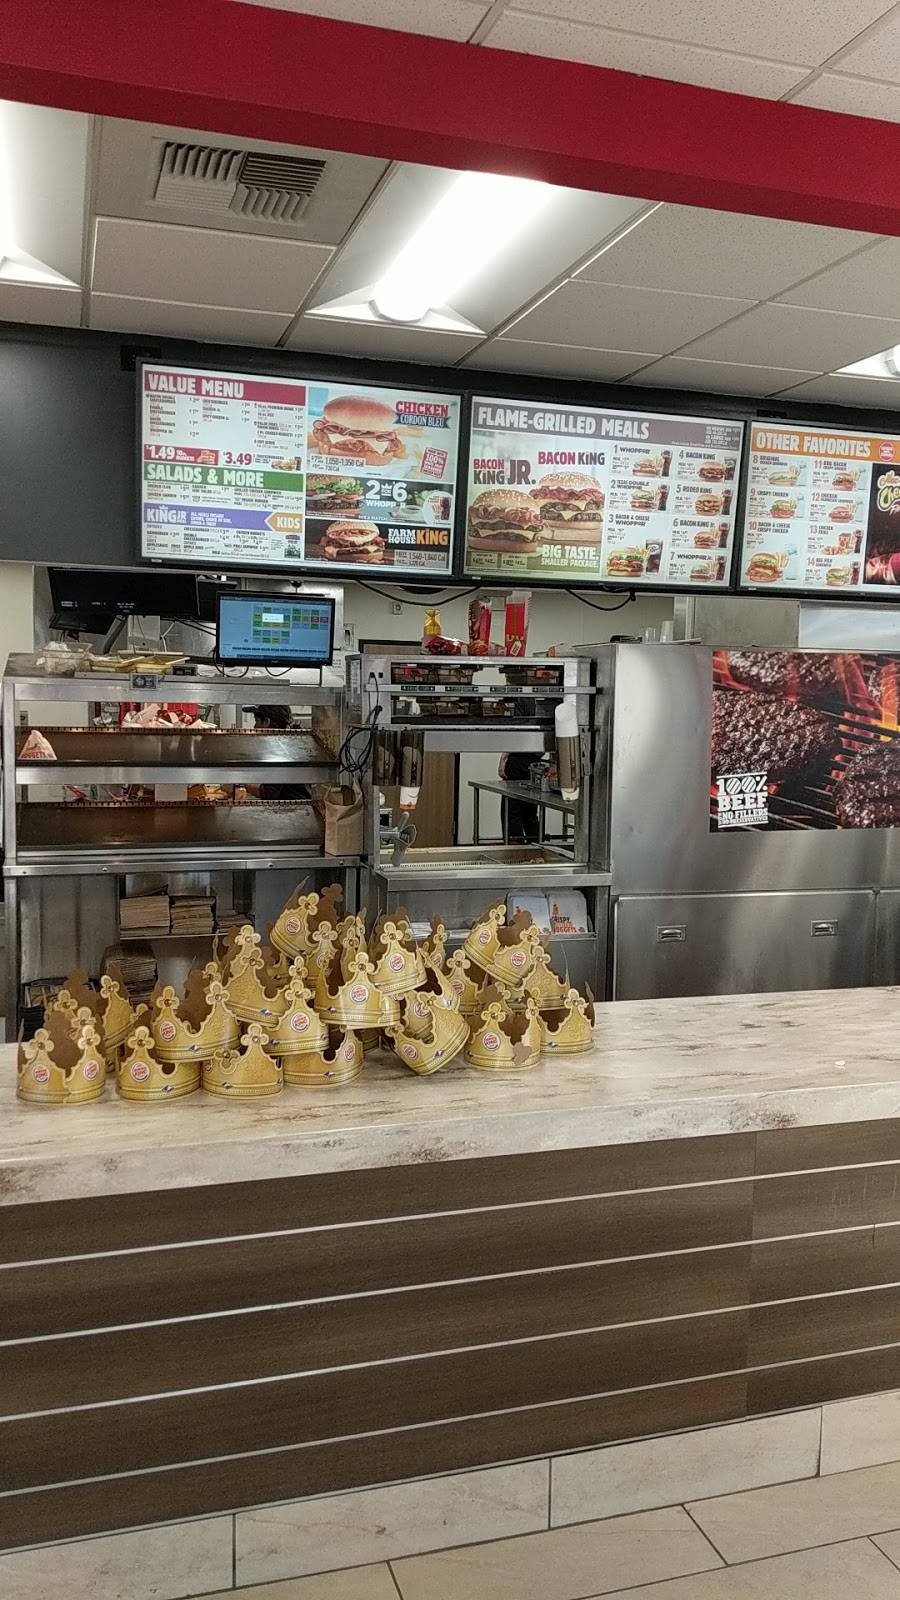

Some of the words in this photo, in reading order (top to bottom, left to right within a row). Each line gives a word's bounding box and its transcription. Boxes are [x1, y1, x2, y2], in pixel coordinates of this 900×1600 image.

[148, 373, 196, 394] VALUE
[202, 379, 244, 398] MENU
[395, 401, 448, 417] CHICKEN
[400, 414, 427, 425] CORDON
[428, 416, 444, 427] BLEU
[478, 407, 596, 435] FLAME-GRILLED
[601, 418, 649, 440] MEALS
[613, 444, 618, 454] 1
[756, 431, 800, 451] OTHER
[803, 436, 871, 458] FAVORITES
[538, 451, 576, 465] BACON
[679, 450, 684, 459] 4
[752, 455, 758, 464] 8
[473, 459, 505, 470] BACON
[147, 464, 202, 483] SALADS
[207, 468, 218, 484] &
[223, 470, 264, 487] MORE
[507, 459, 536, 485] JR.
[365, 479, 380, 499] 2
[610, 479, 616, 489] 2
[676, 484, 681, 493] 5
[750, 488, 756, 496] 9
[146, 508, 176, 523] KING
[608, 514, 614, 523] 3
[276, 516, 301, 529] KIDS
[673, 518, 678, 527] 6
[388, 528, 416, 537] FARM
[416, 528, 448, 545] KING
[388, 536, 416, 544] HOUSE
[542, 545, 562, 558] BIG
[564, 546, 600, 560] TASTE.
[670, 552, 675, 560] 7
[541, 558, 568, 566] SMALLER
[716, 775, 768, 796] 100%
[717, 792, 768, 812] BEEF
[722, 811, 733, 819] NO
[735, 808, 768, 819] FILLERS
